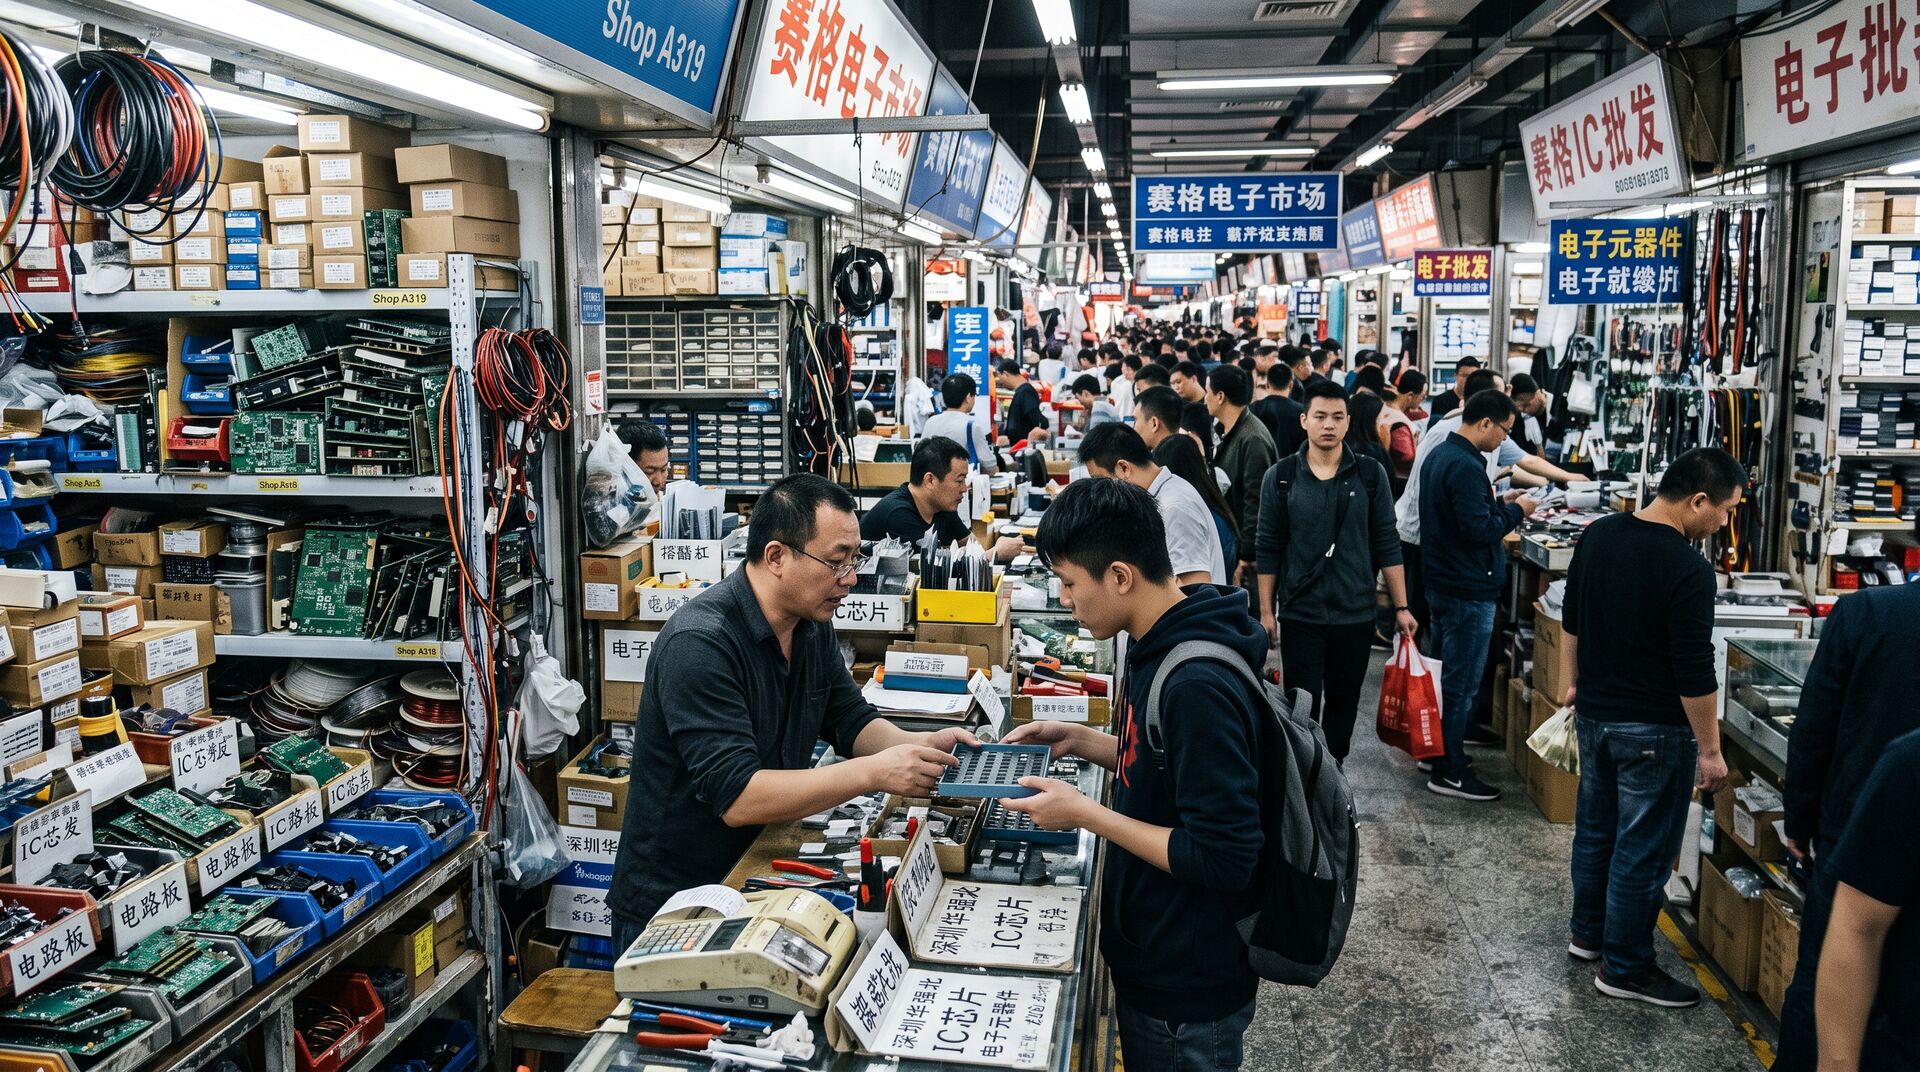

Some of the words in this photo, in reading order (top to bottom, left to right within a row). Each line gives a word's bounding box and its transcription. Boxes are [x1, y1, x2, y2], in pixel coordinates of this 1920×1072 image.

[603, 0, 657, 66] Shop
[656, 25, 706, 82] A319
[1775, 0, 1920, 124] 电子批
[1530, 82, 1664, 195] 赛格IC批发
[1147, 182, 1326, 213] 赛格电子市场
[1558, 226, 1682, 259] 电子元器件
[1417, 255, 1488, 279] 电子批发
[373, 293, 400, 305] Shop
[401, 293, 427, 303] A319
[397, 647, 416, 656] Shop
[21, 816, 81, 862] IC芯发
[270, 800, 320, 841] IC路板
[205, 836, 258, 879] 电路板
[120, 880, 183, 929] 电路板
[990, 896, 1033, 950] IC芯片
[18, 925, 89, 979] 电路板
[932, 987, 987, 1054] IC芯片
[980, 990, 1020, 1058] 电子元器件
